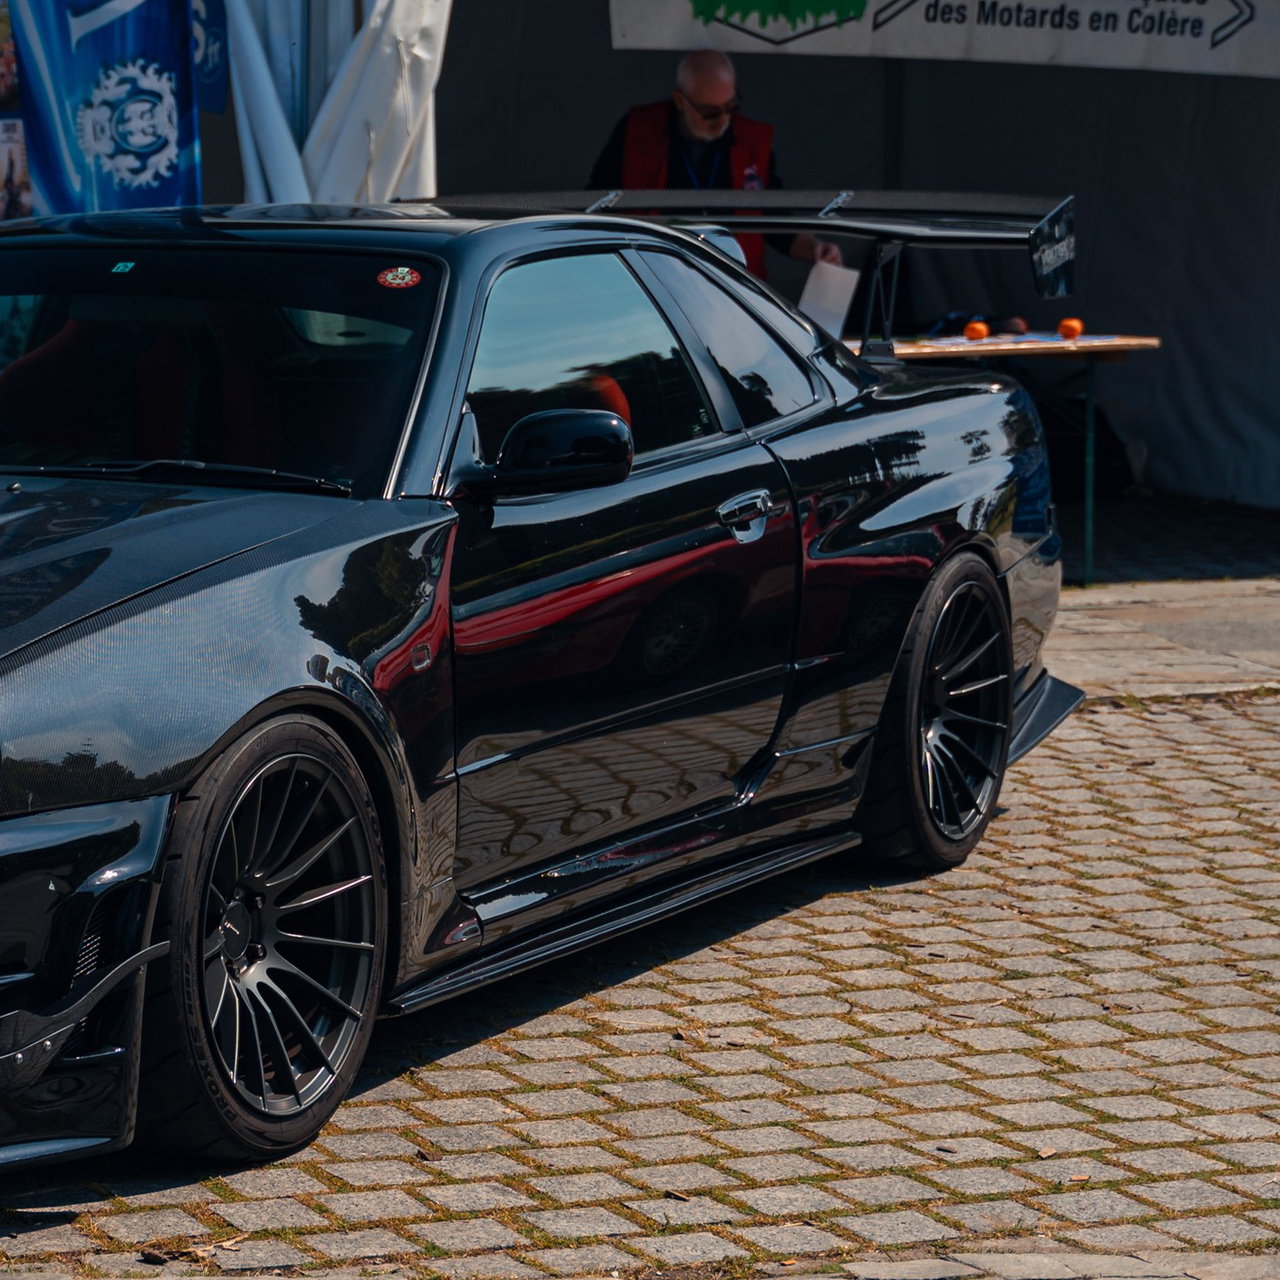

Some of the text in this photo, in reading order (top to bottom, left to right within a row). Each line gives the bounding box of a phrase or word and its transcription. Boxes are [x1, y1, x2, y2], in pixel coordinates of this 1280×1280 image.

[976, 0, 1080, 32] Motards
[1088, 10, 1118, 33] en
[1127, 7, 1205, 38] Colère
